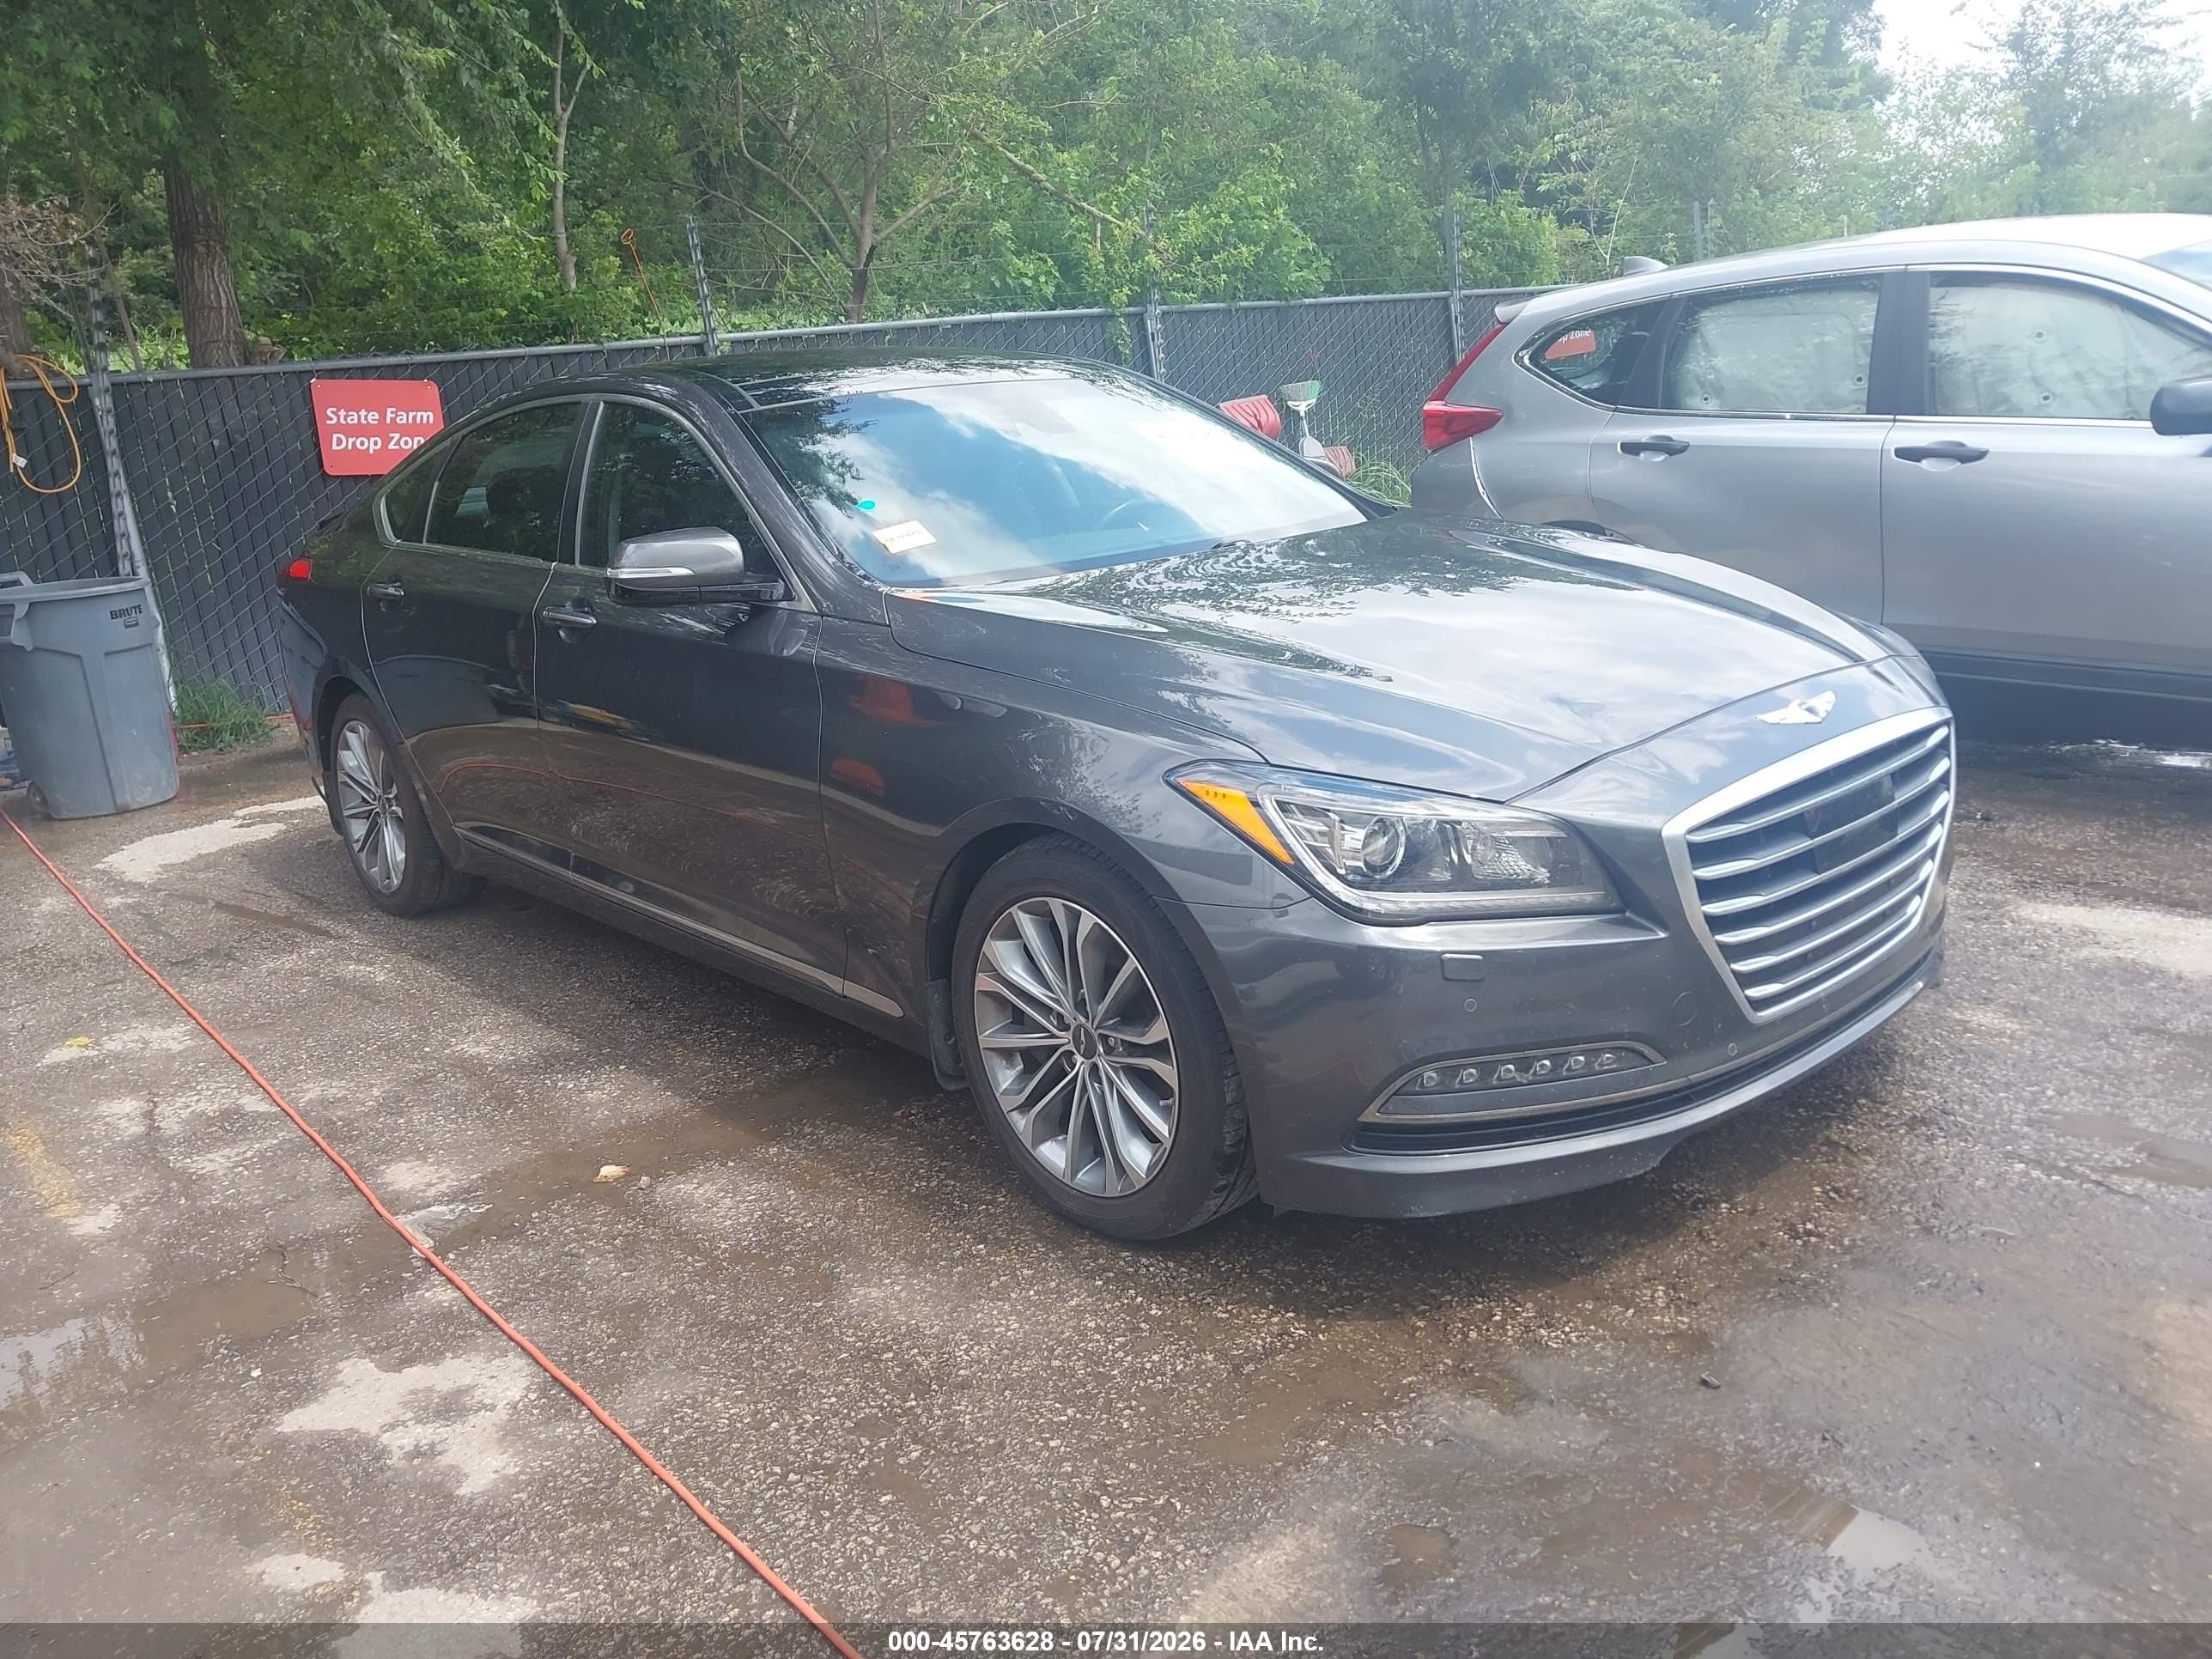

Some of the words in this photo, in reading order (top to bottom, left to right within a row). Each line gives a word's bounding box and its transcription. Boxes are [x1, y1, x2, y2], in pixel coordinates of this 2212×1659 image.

[325, 407, 380, 424] State
[386, 407, 434, 424] Farm
[331, 433, 382, 454] Drop
[387, 433, 426, 450] Zon
[109, 604, 143, 620] BRUTE
